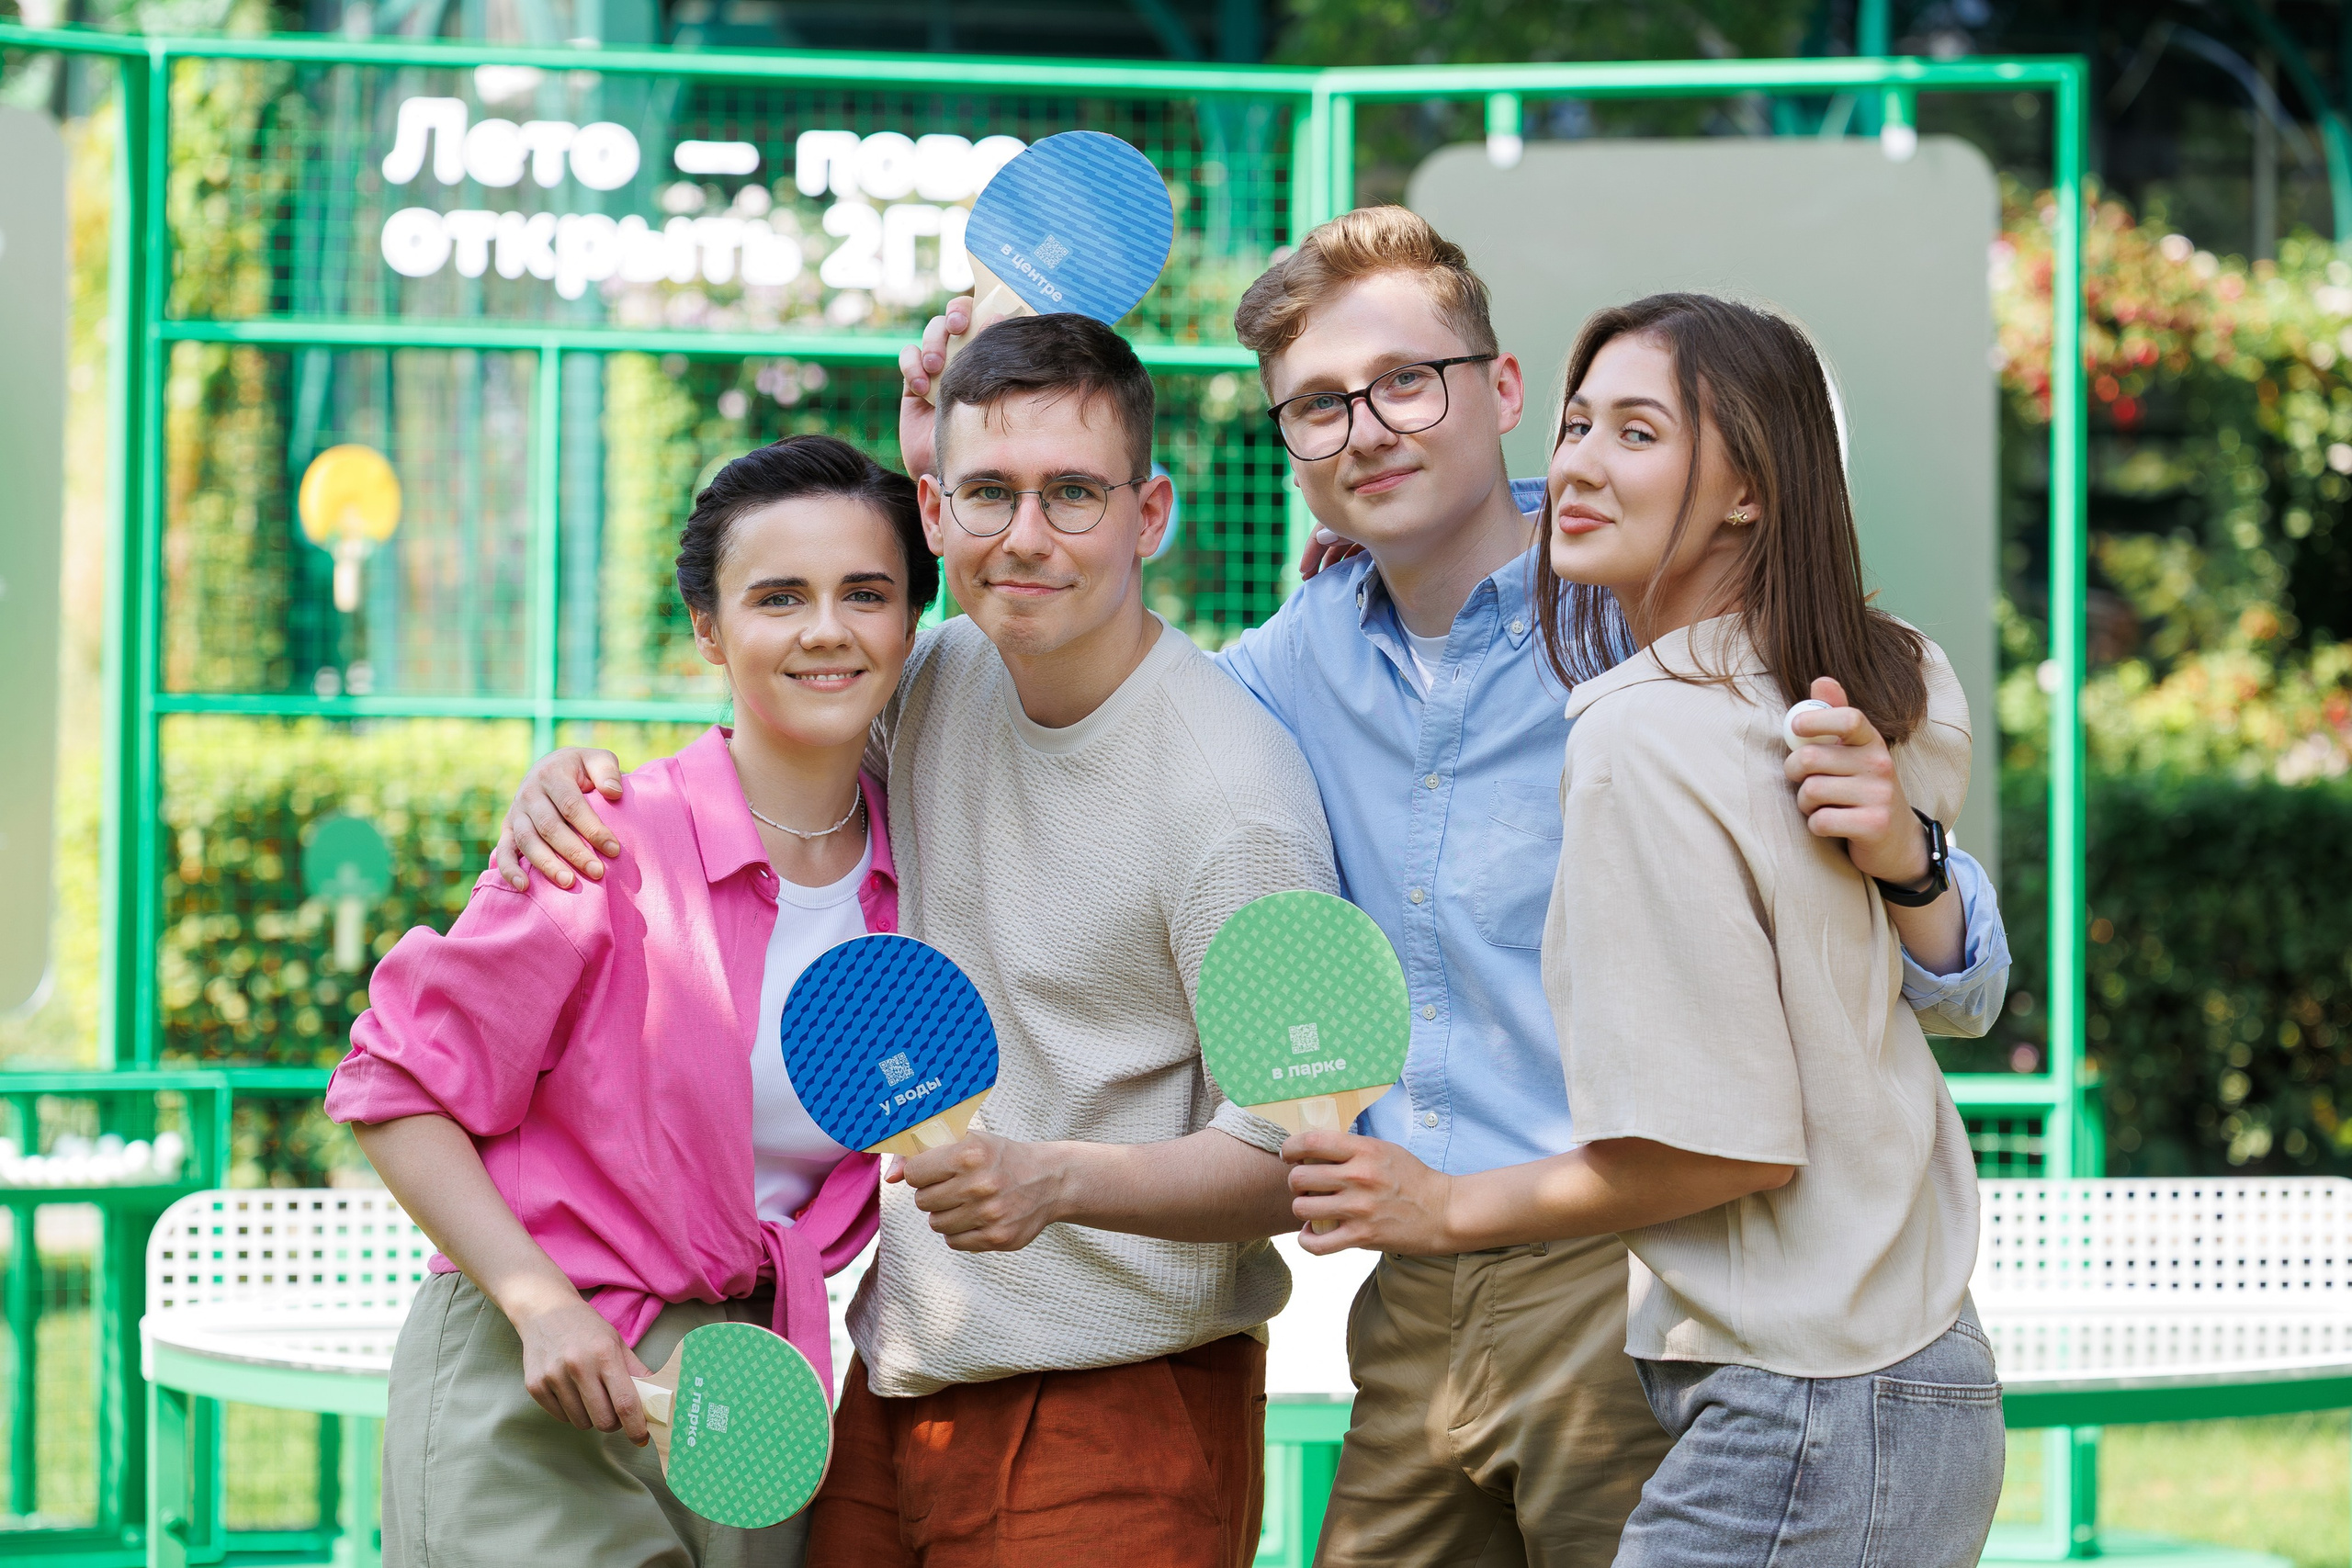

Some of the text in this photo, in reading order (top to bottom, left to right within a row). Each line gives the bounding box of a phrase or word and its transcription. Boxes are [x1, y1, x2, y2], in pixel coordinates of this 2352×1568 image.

[382, 96, 640, 190] Лето
[796, 130, 1029, 202] пово
[381, 200, 976, 300] открыть 2Г
[1001, 243, 1063, 303] в центре
[878, 1077, 943, 1116] у воды
[1272, 1058, 1347, 1080] в парке
[687, 1376, 704, 1448] в парке
